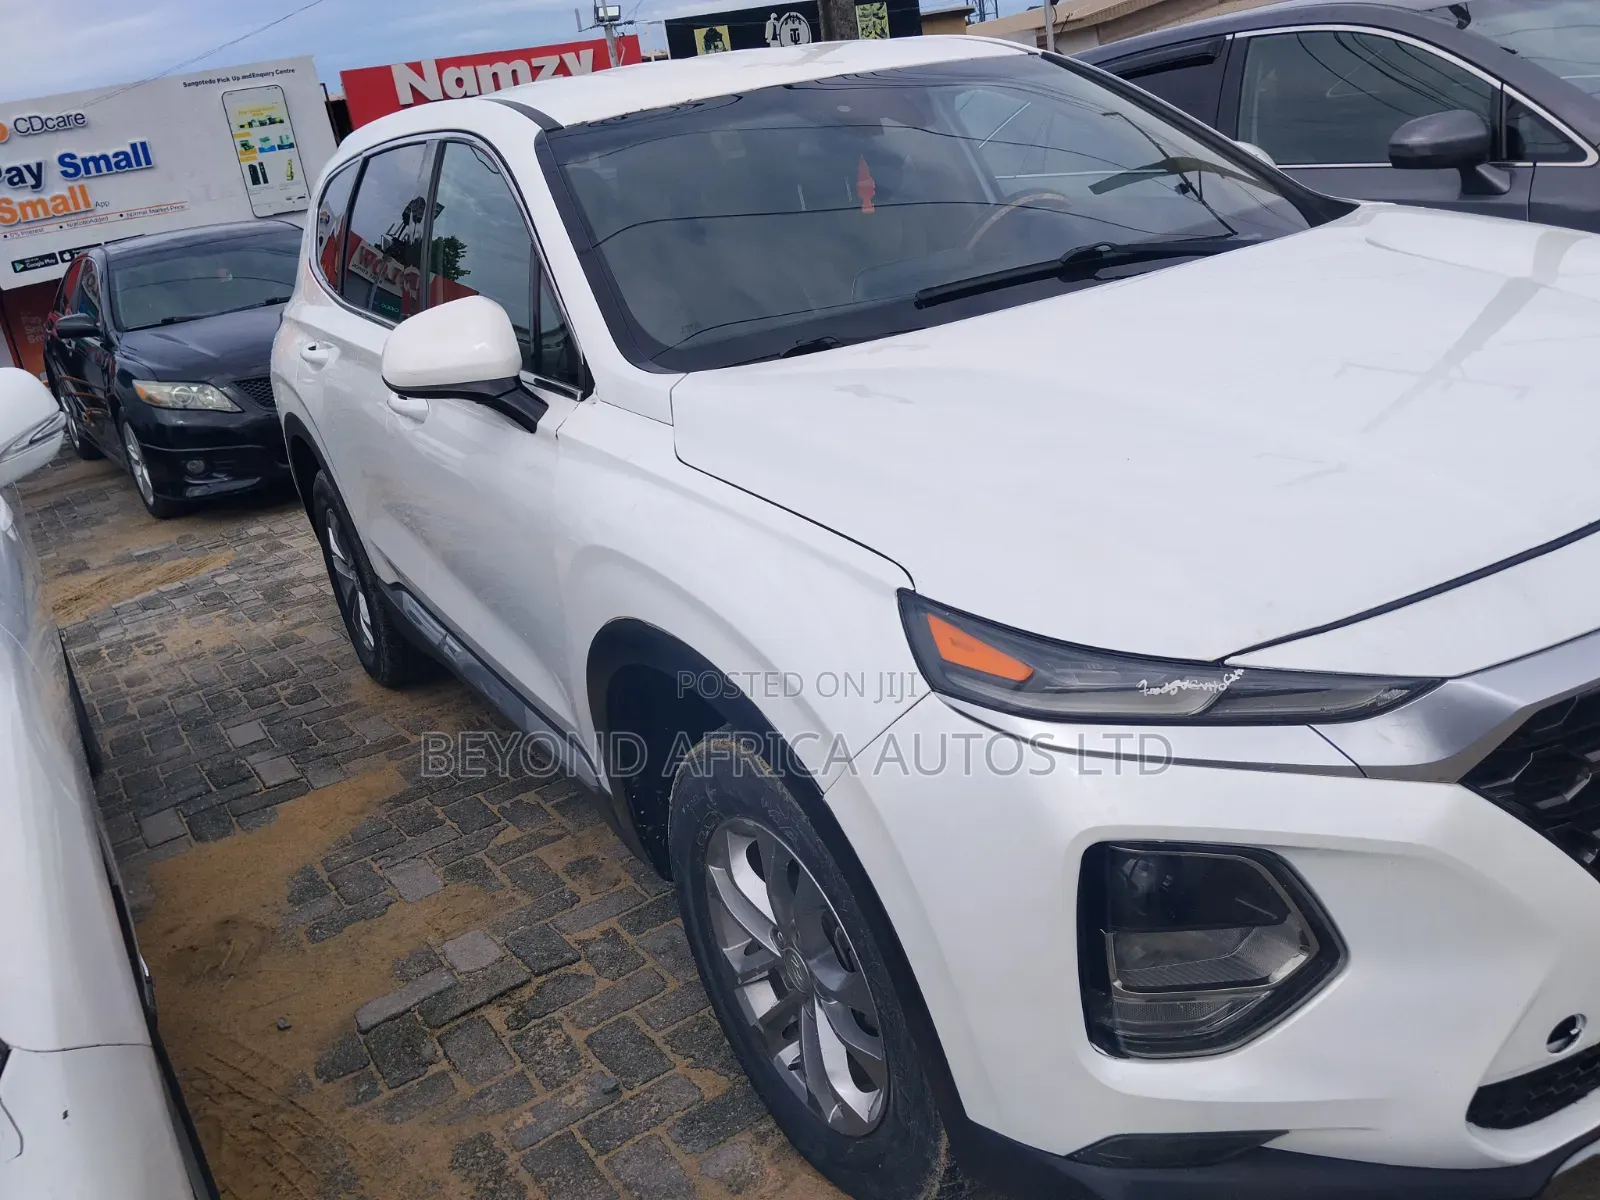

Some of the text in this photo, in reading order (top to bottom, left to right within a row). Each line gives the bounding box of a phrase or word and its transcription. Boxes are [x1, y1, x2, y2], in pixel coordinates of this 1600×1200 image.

[183, 79, 216, 87] Sangotedo
[13, 112, 87, 135] CDcare
[57, 141, 153, 179] Small
[0, 184, 92, 224] Small
